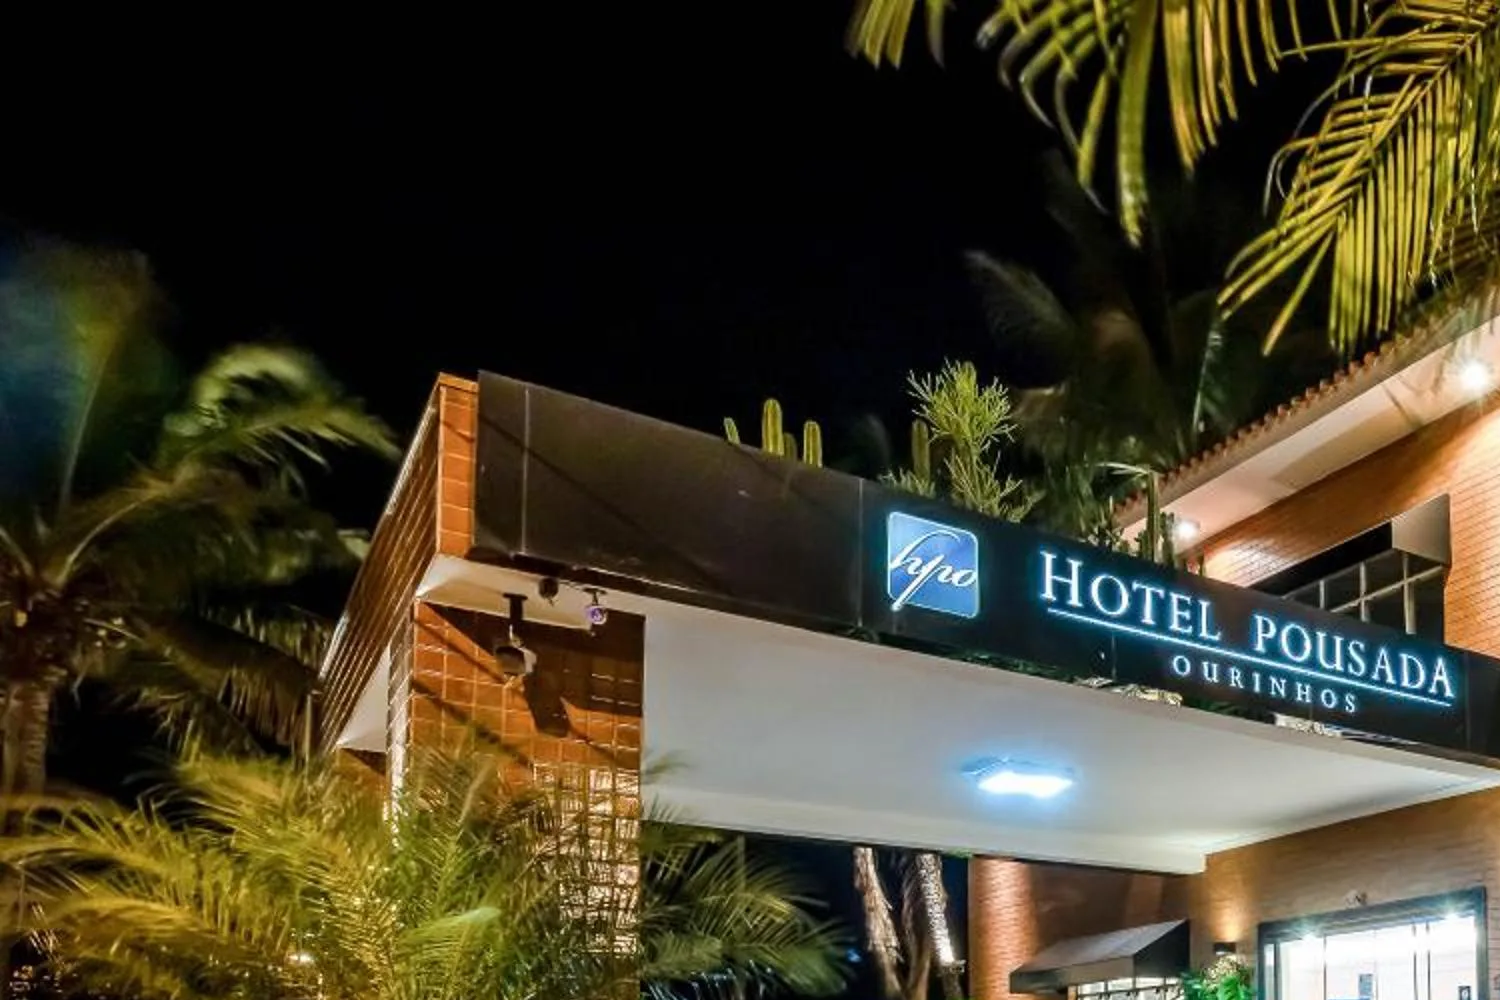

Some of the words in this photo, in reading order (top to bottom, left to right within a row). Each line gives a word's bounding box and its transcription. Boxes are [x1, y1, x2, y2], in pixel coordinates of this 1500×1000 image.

[1039, 551, 1221, 641] HOTEL
[1253, 615, 1454, 698] POUSADA
[1173, 655, 1356, 713] OURINHOS
